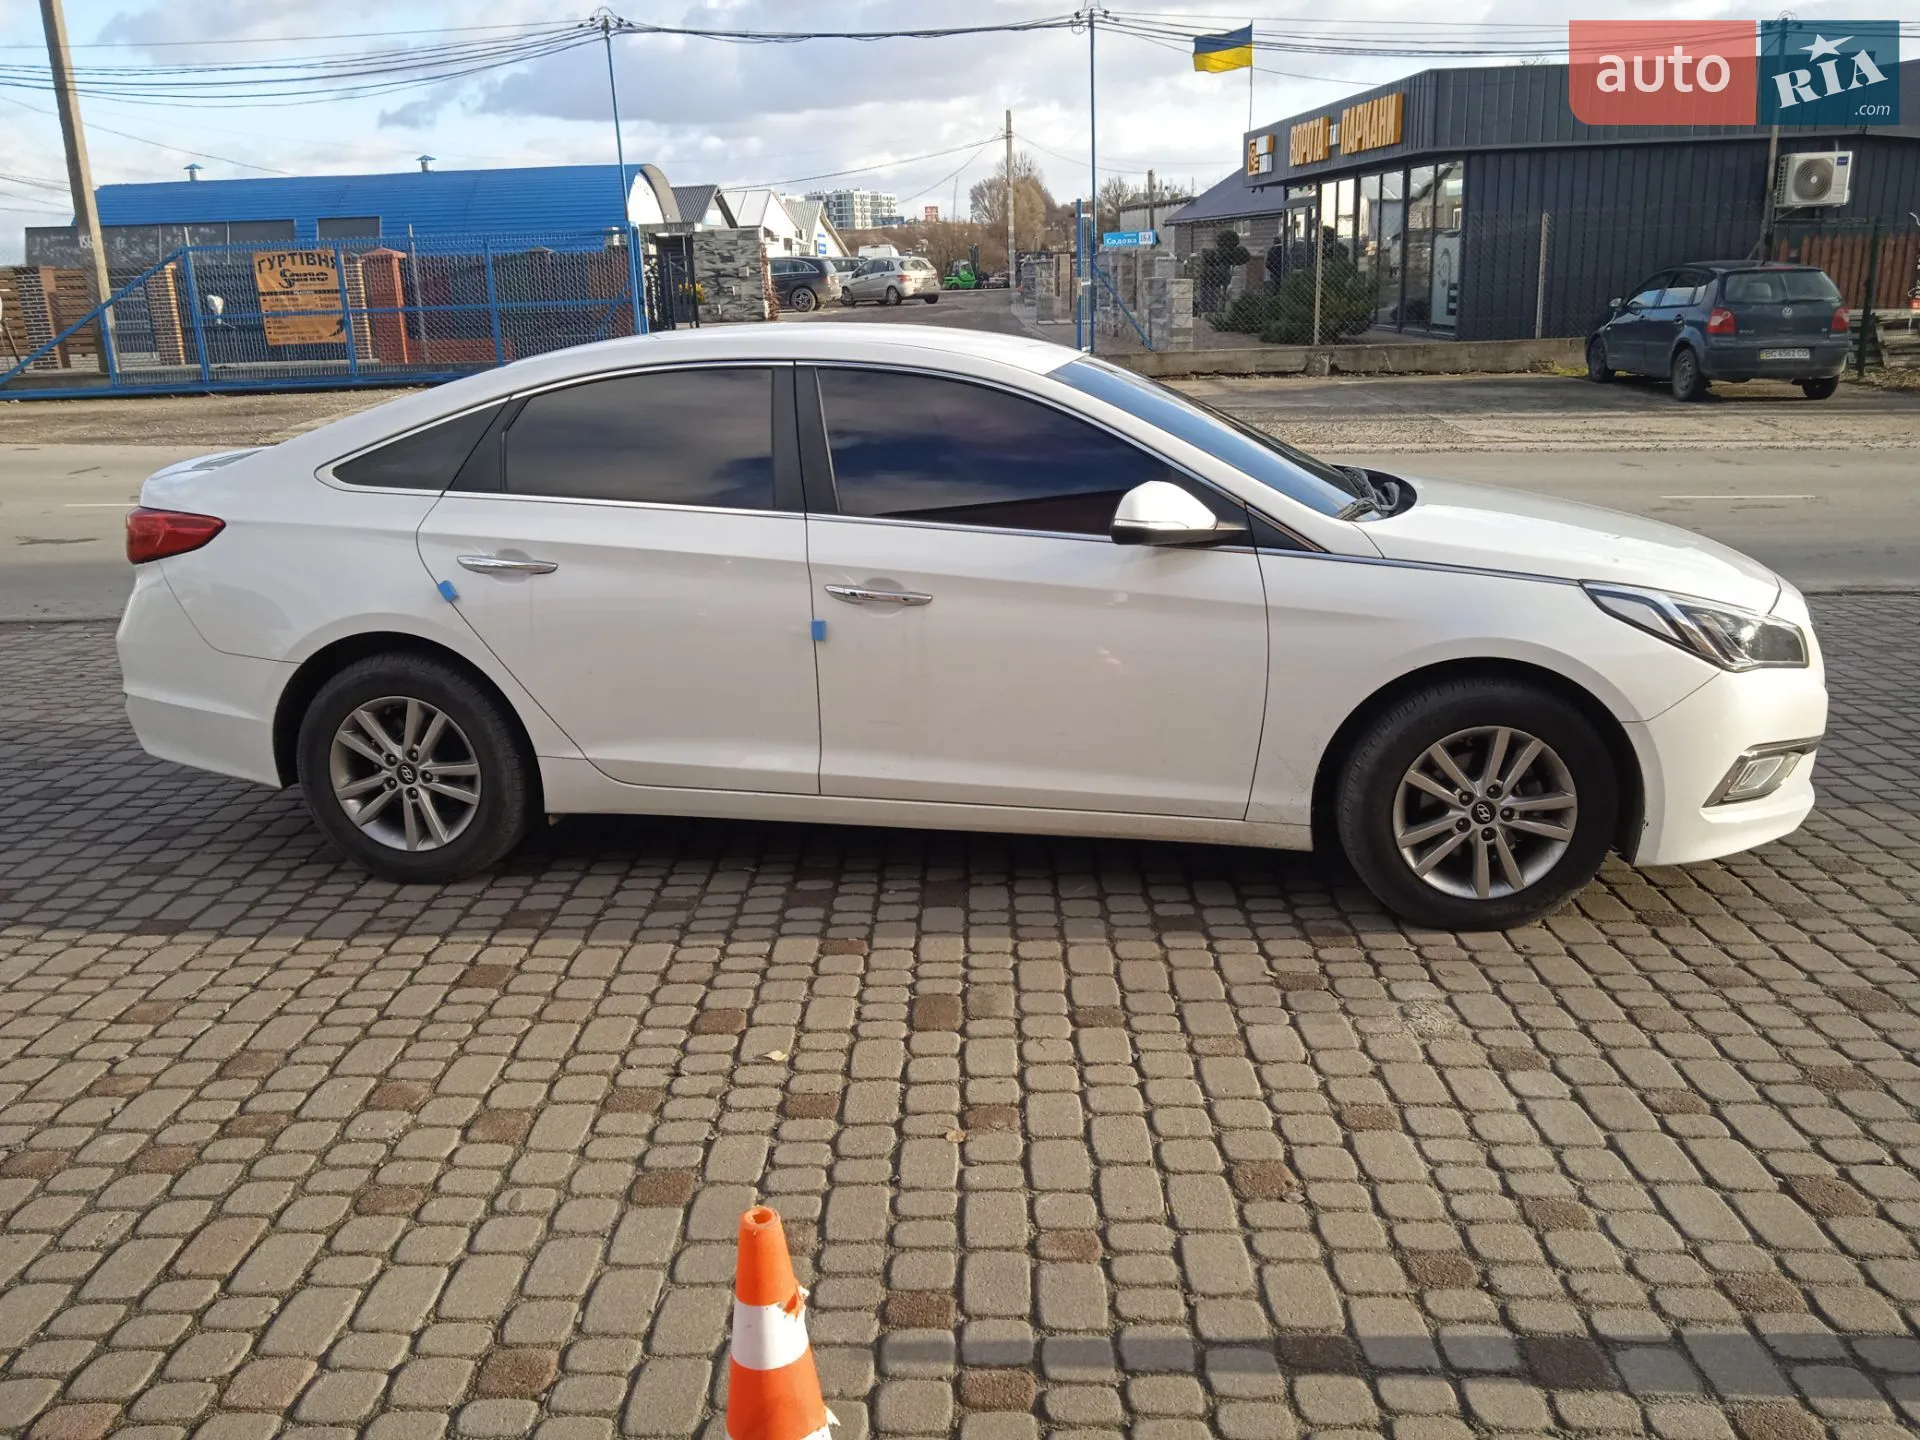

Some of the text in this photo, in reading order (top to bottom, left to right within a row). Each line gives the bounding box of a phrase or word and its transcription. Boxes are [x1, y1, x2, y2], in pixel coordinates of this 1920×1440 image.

[1289, 116, 1326, 167] ВОРОТА
[1340, 92, 1400, 155] ПАРКАНИ
[1106, 237, 1137, 246] Садова
